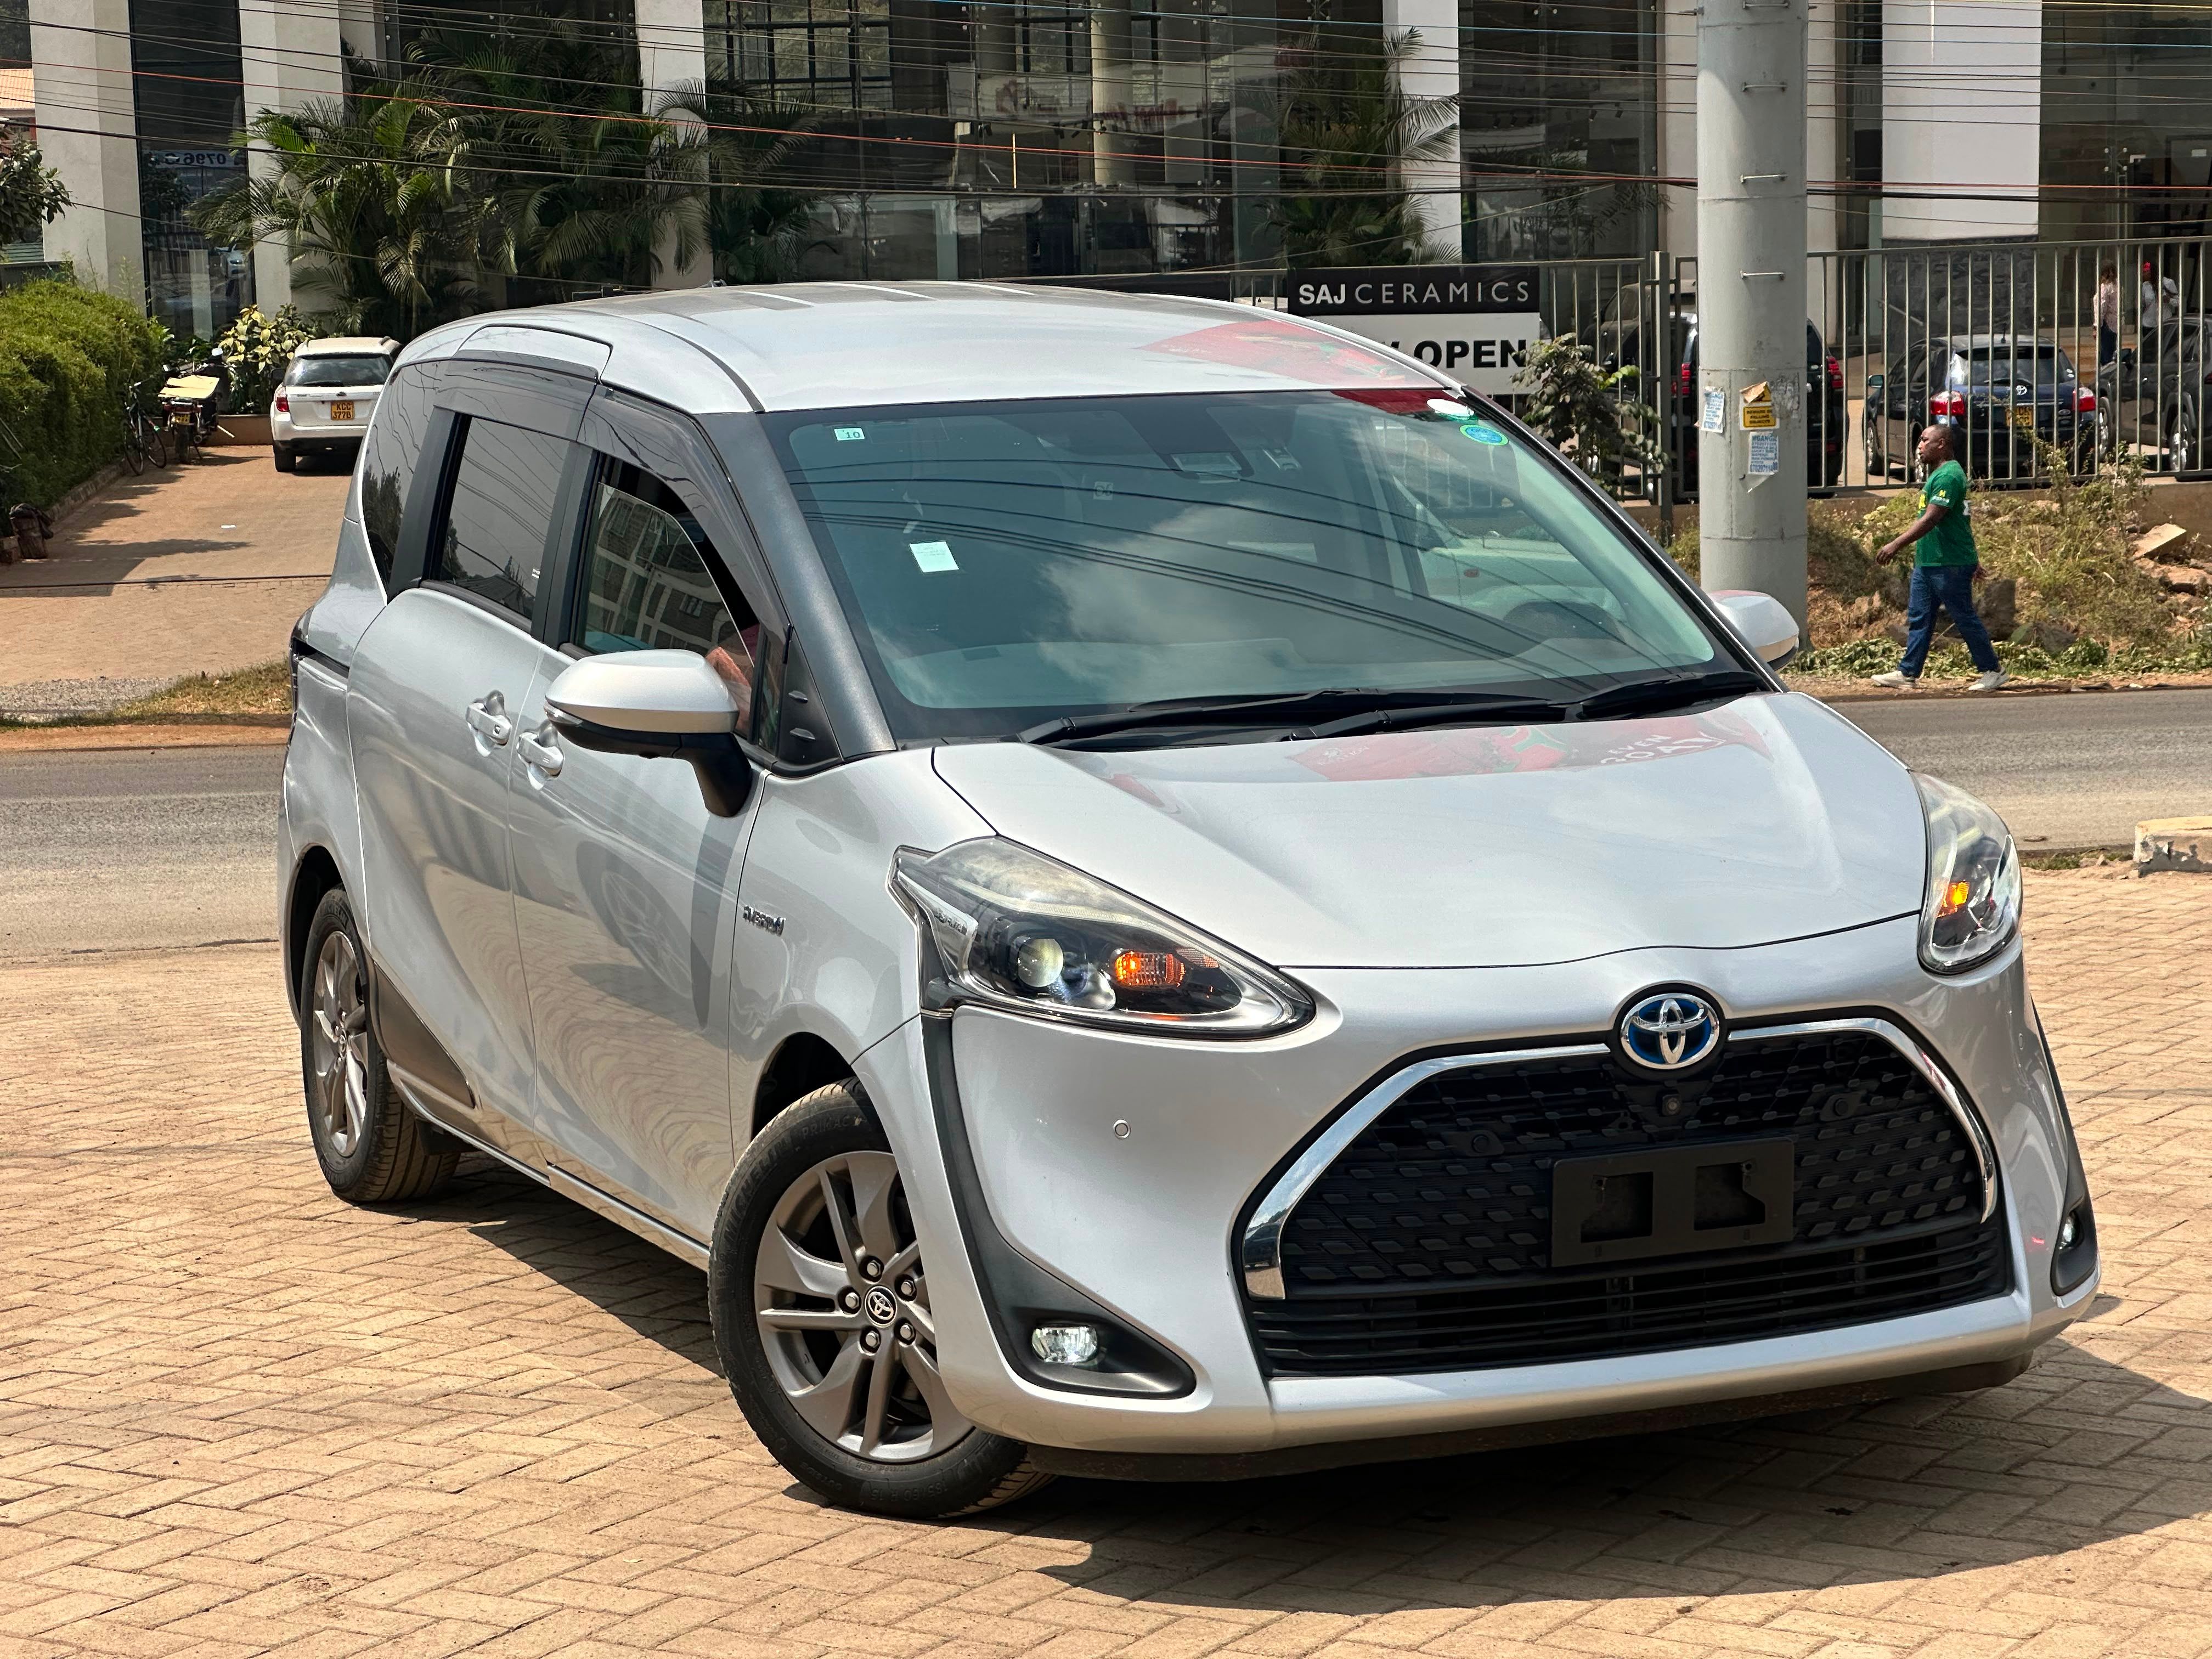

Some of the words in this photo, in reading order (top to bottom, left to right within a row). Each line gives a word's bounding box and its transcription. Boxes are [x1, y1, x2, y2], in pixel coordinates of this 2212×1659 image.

[1299, 284, 1346, 304] SAJ
[1355, 280, 1529, 304] CERAMICS
[1414, 339, 1527, 368] OPEN
